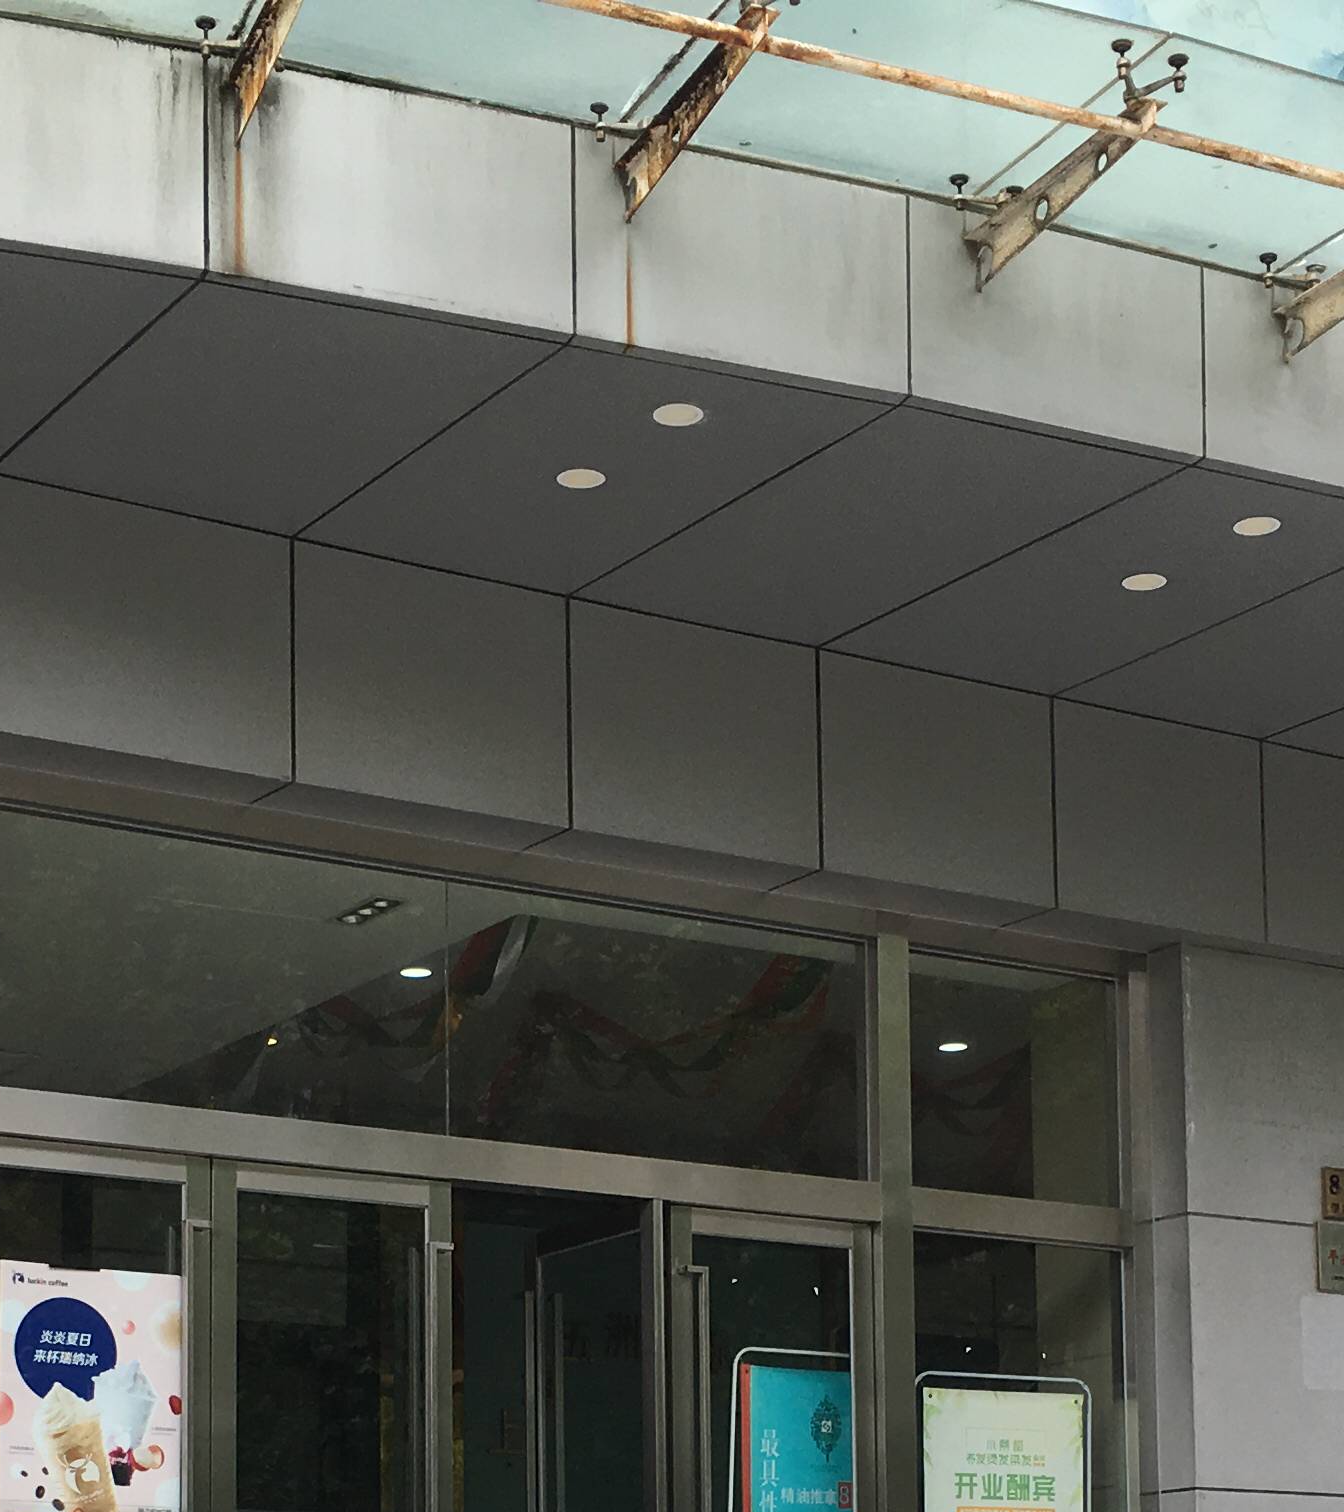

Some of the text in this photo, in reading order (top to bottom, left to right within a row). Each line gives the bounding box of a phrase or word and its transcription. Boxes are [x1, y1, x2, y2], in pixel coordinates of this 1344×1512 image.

[39, 1329, 92, 1347] 炎炎夏日
[33, 1348, 99, 1367] 来杯瑞纳冰
[954, 1472, 1056, 1502] 开业酬宾
